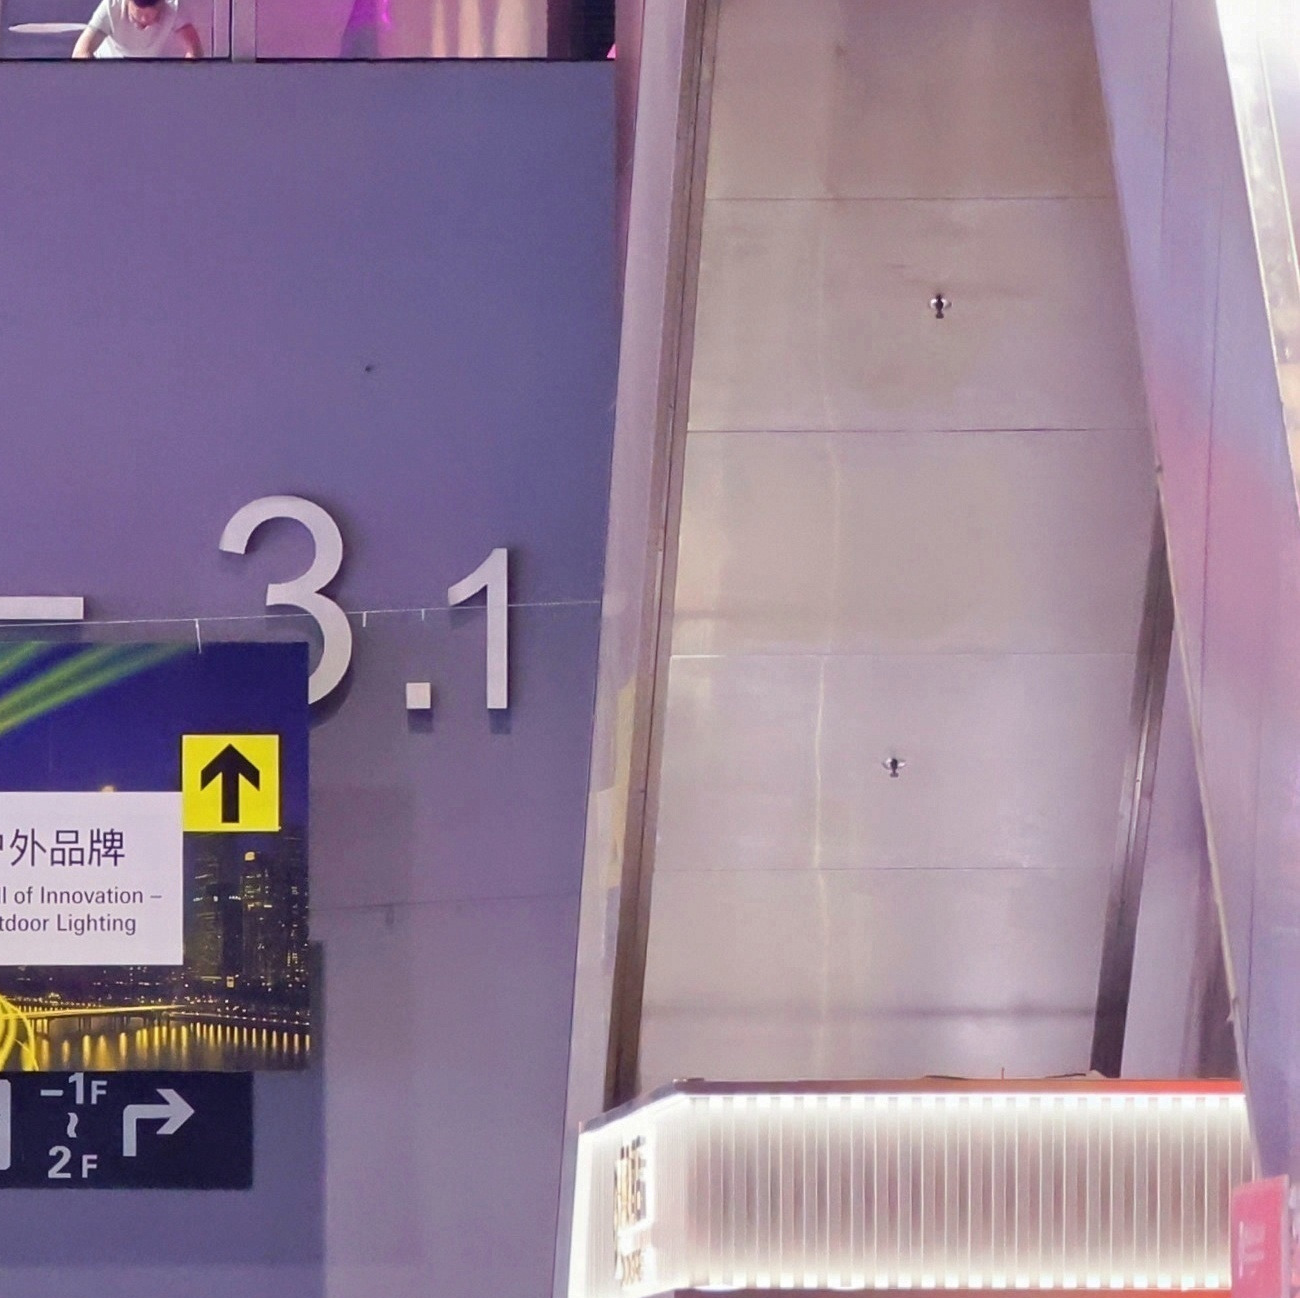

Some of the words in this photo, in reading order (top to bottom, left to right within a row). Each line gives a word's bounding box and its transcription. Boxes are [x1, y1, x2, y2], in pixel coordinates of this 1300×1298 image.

[217, 495, 509, 709] 3.1
[14, 886, 33, 904] of
[41, 886, 144, 904] Innovation
[57, 913, 136, 936] Lighting
